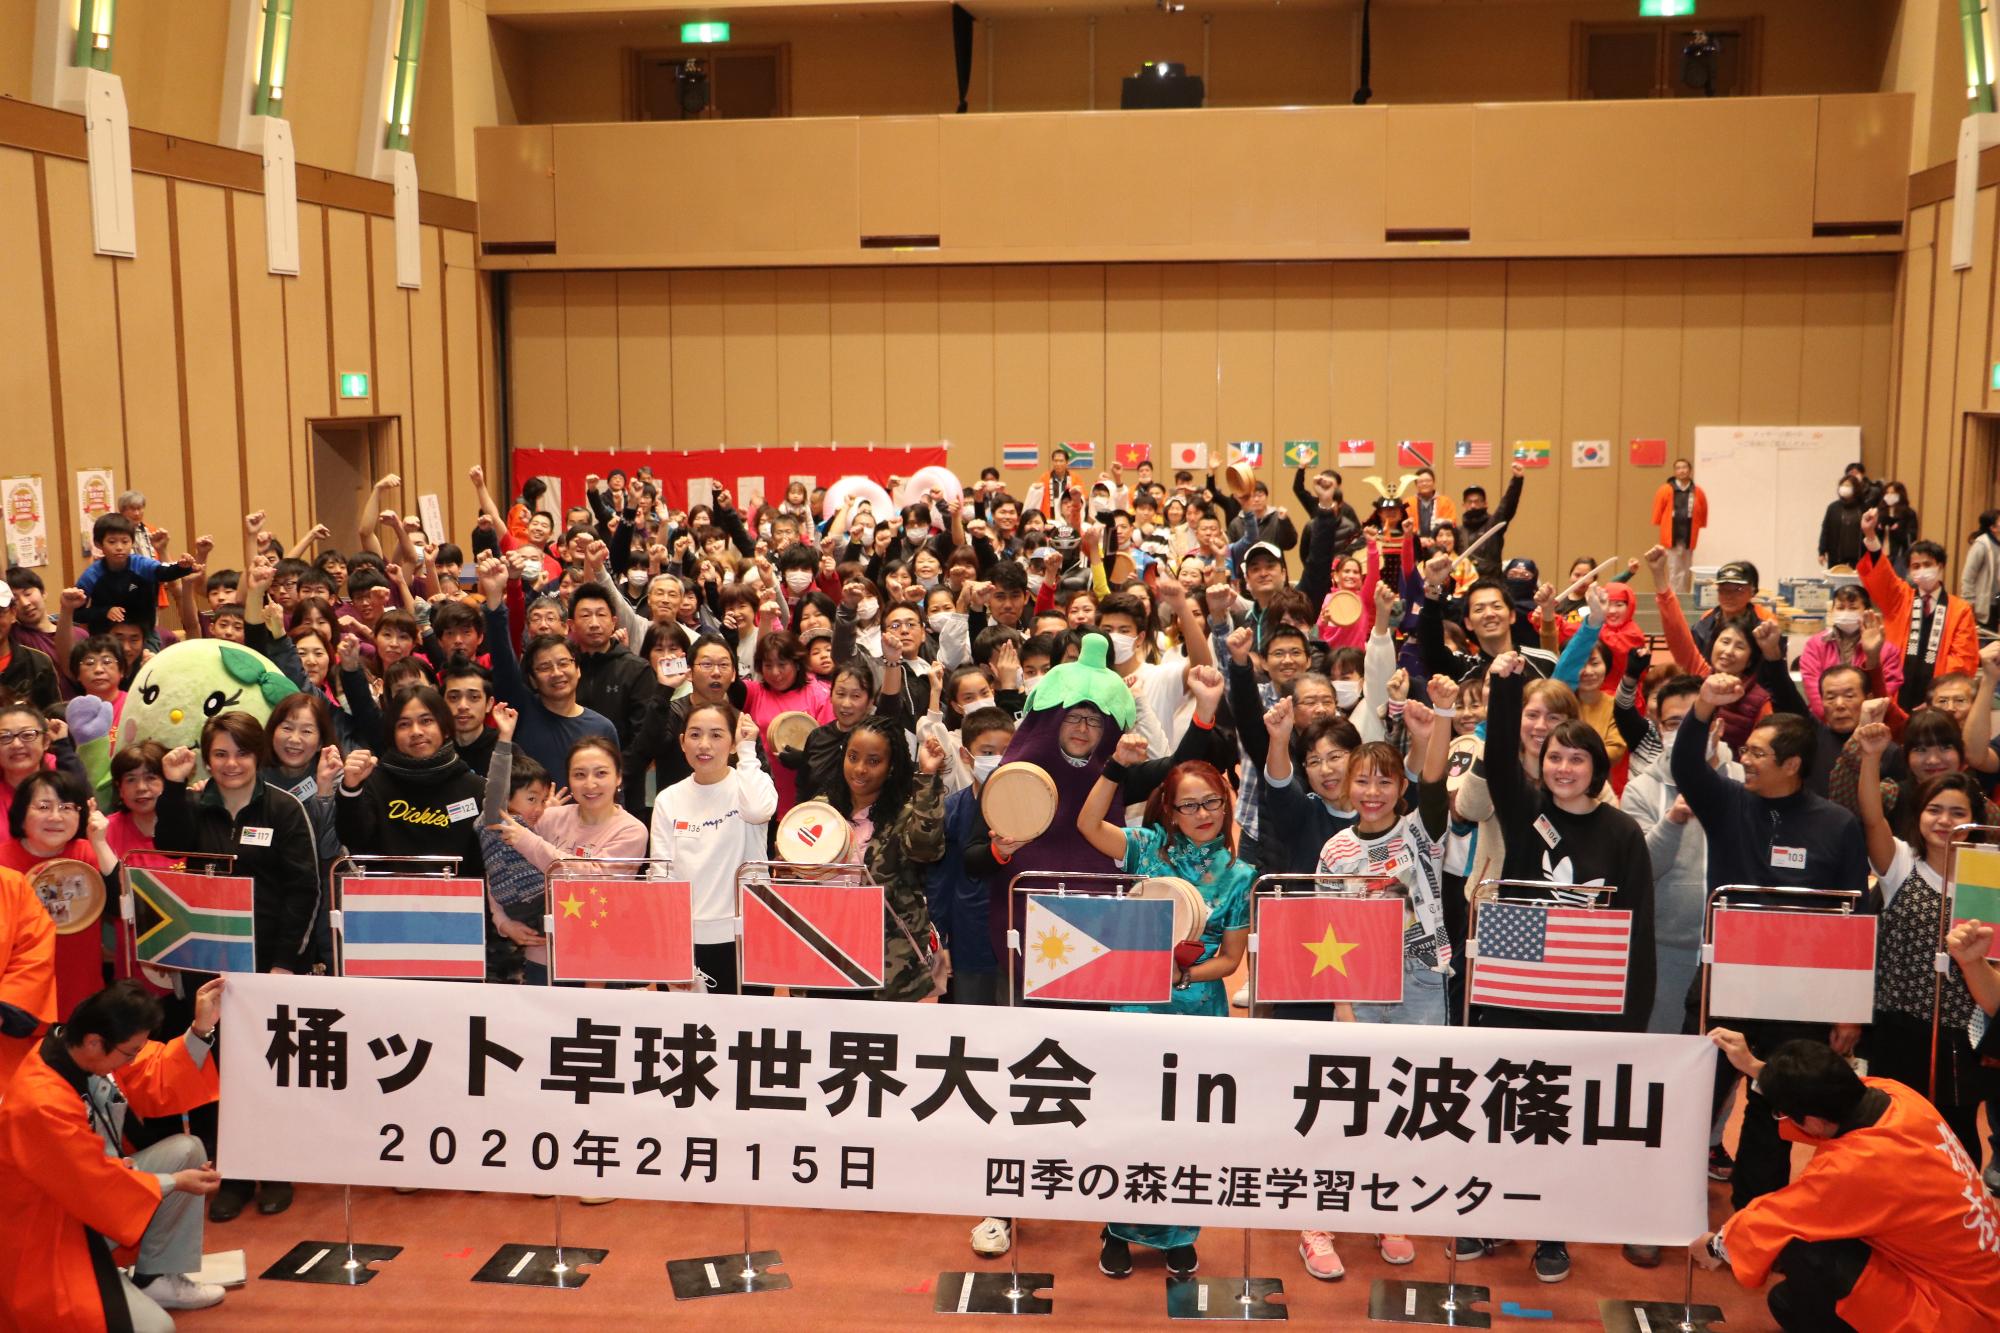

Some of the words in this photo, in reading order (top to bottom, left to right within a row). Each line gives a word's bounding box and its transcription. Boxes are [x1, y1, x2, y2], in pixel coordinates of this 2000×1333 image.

[301, 781, 314, 792] 117
[461, 802, 476, 813] 122
[388, 800, 449, 827] Dickies
[688, 824, 701, 833] 136
[257, 832, 270, 841] 117
[1546, 828, 1558, 844] 106
[1397, 854, 1410, 865] 113
[1788, 853, 1804, 863] 103
[265, 1004, 1097, 1128] 桶ット卓球世界大会
[1161, 1053, 1237, 1124] in
[1293, 1054, 1665, 1148] 丹波篠山
[379, 1123, 876, 1190] 2020年2月15日
[986, 1157, 1541, 1216] 四季の森生涯学習センター
